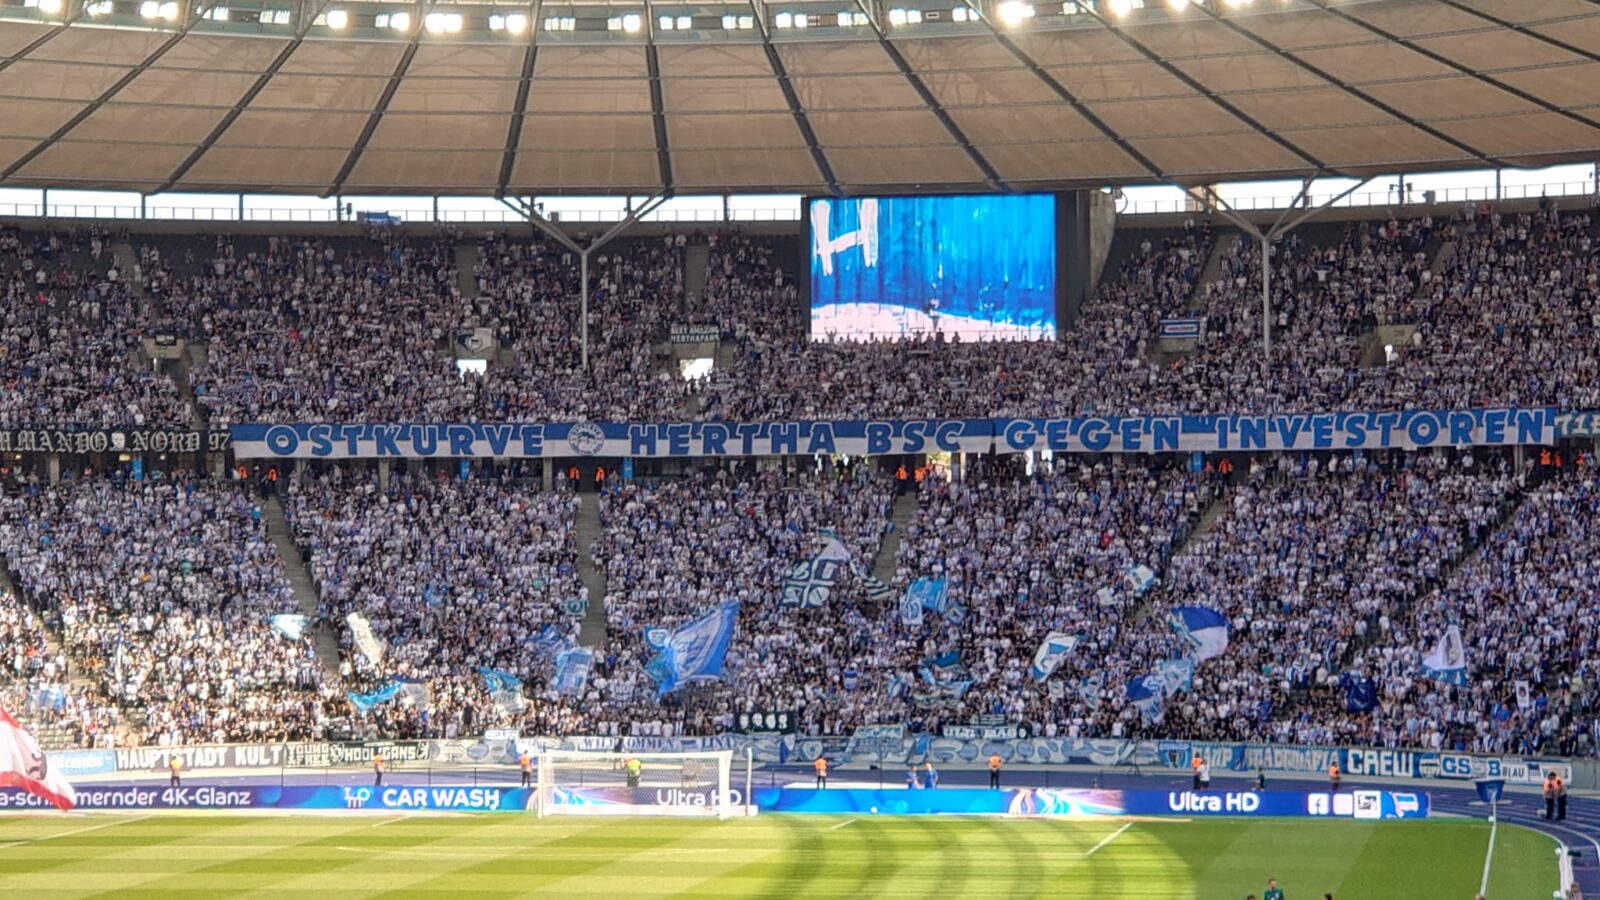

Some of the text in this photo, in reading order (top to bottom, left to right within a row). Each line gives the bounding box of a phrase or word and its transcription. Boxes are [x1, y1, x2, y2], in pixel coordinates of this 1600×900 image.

[810, 199, 879, 276] H
[131, 430, 200, 453] NORD
[208, 432, 231, 451] 97
[265, 423, 544, 457] OSTKURVE
[629, 421, 836, 456] HERTHA
[864, 420, 963, 454] BSC
[1004, 416, 1182, 451] GEGEN
[1213, 407, 1546, 450] INVESTOREN
[234, 744, 282, 767] KULT
[345, 746, 417, 761] HOOLIGANS
[1347, 748, 1414, 777] CREW
[1442, 756, 1472, 774] GS
[162, 787, 251, 806] 4K-Glanz
[382, 788, 500, 808] CAR WASH
[656, 788, 706, 806] Ultra
[1168, 791, 1260, 812] Ultra HD
